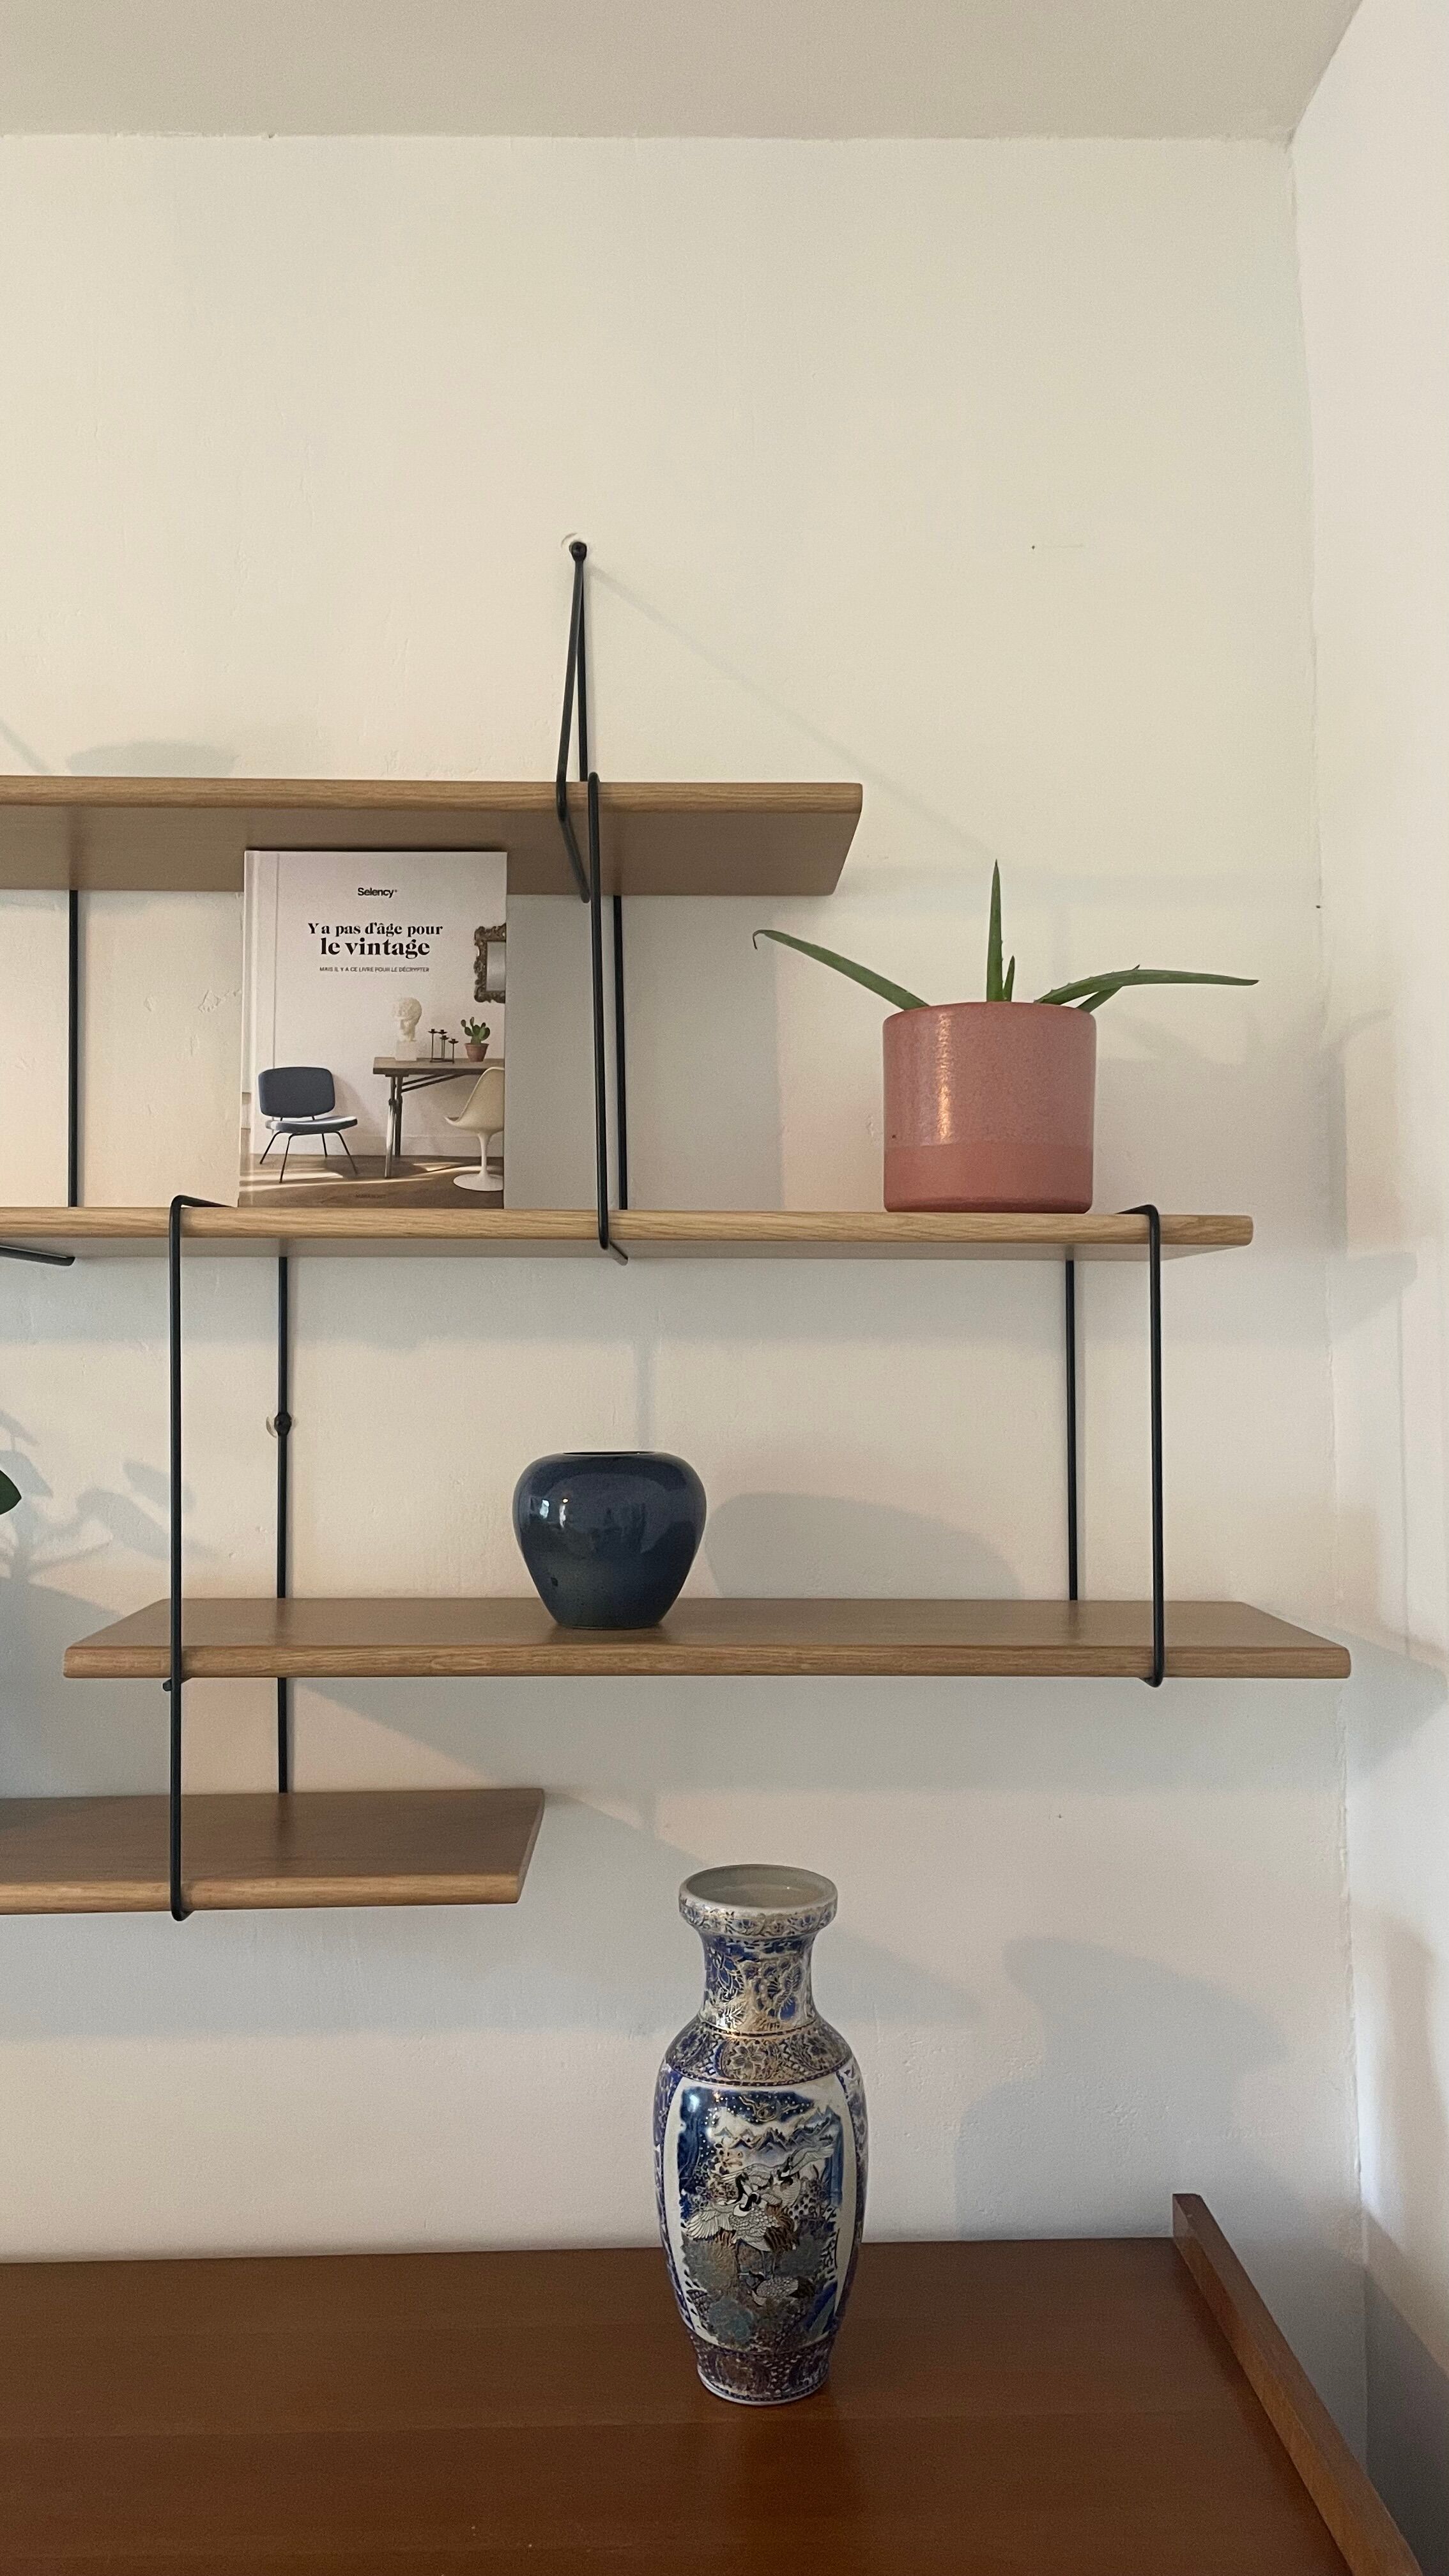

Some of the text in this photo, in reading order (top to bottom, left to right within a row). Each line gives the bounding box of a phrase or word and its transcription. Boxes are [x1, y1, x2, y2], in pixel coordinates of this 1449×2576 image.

[357, 887, 394, 899] Selency
[321, 925, 330, 935] a
[335, 925, 361, 937] pas
[407, 926, 443, 938] pour
[320, 937, 431, 960] le vintage
